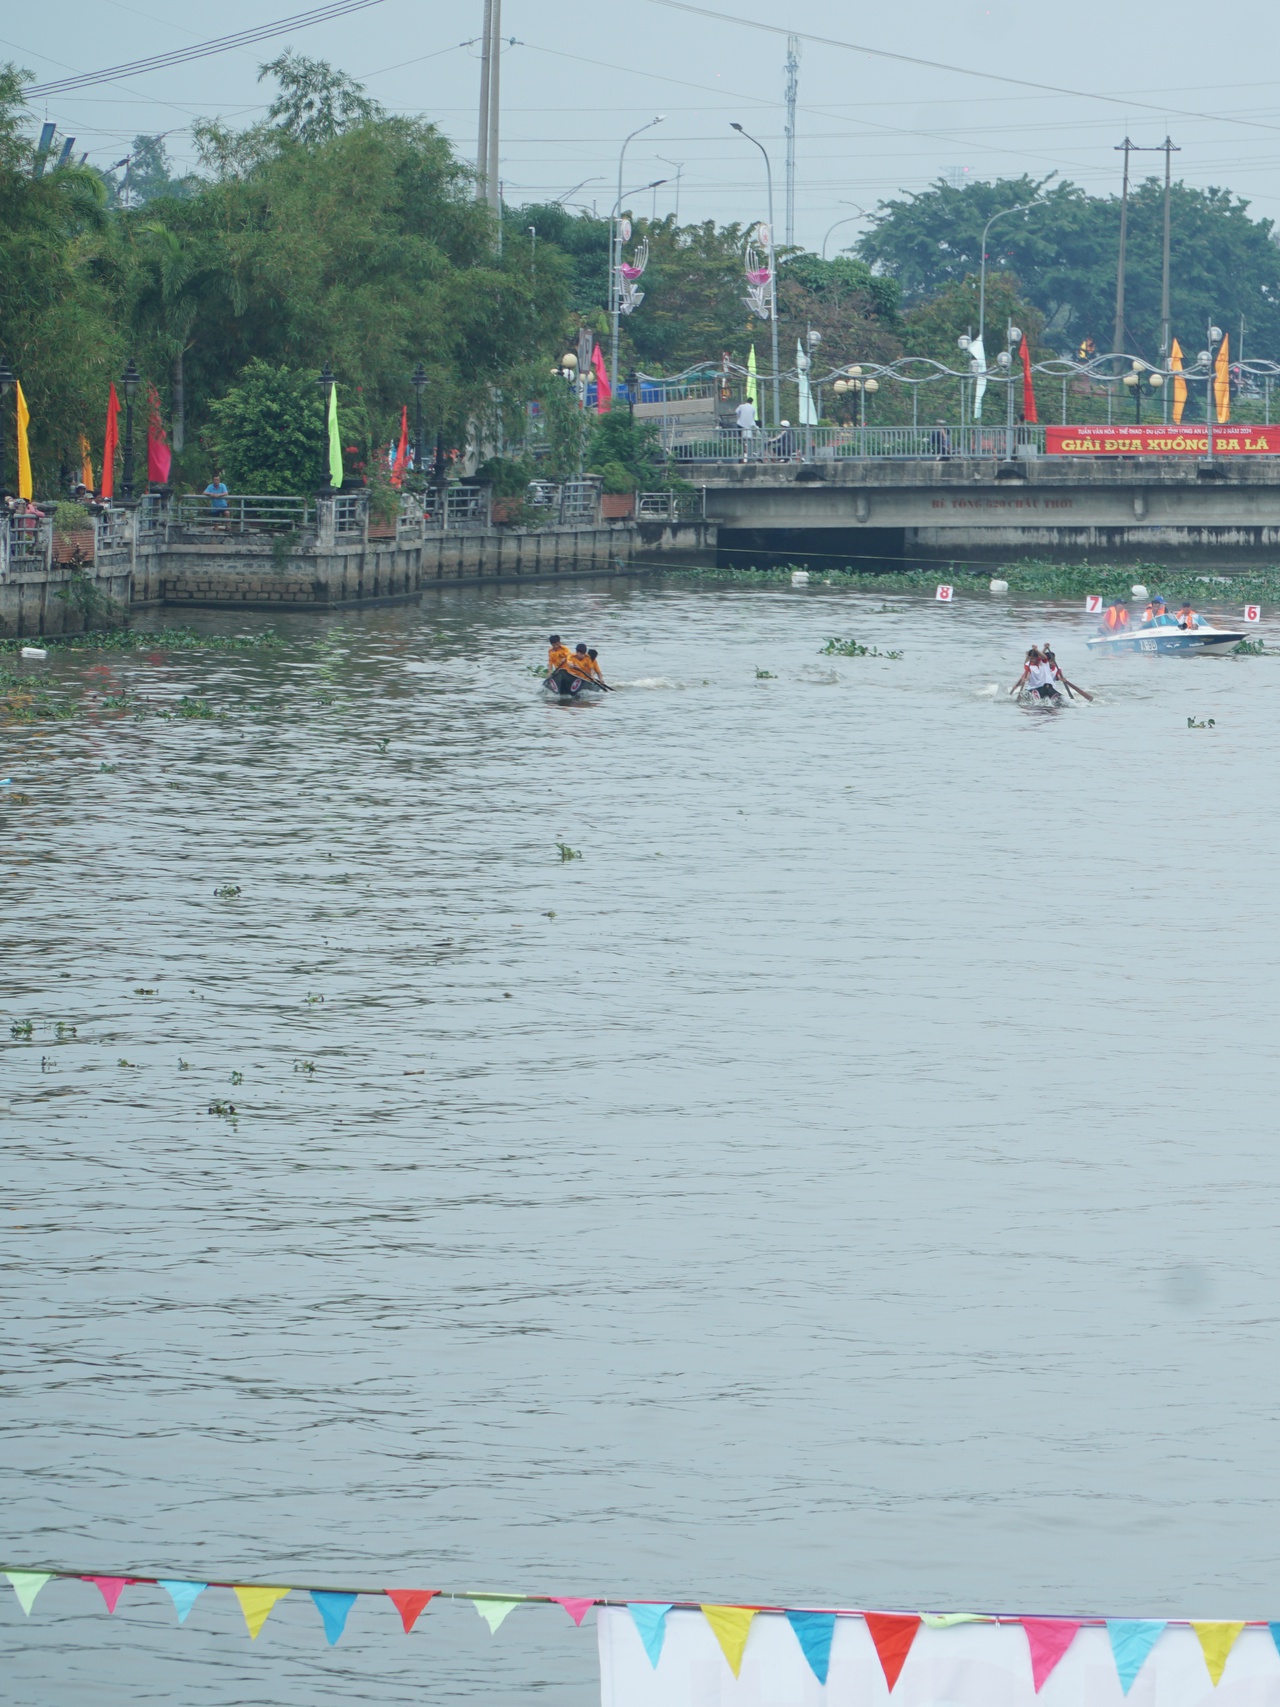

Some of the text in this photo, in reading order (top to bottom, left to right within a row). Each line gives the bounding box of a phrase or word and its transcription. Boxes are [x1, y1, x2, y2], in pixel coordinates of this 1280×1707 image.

[1061, 435, 1269, 451] GIẢI ĐUA XUỒNG BA LÁ
[939, 587, 949, 599] 8
[1090, 597, 1100, 611] 7
[1248, 607, 1258, 621] 6
